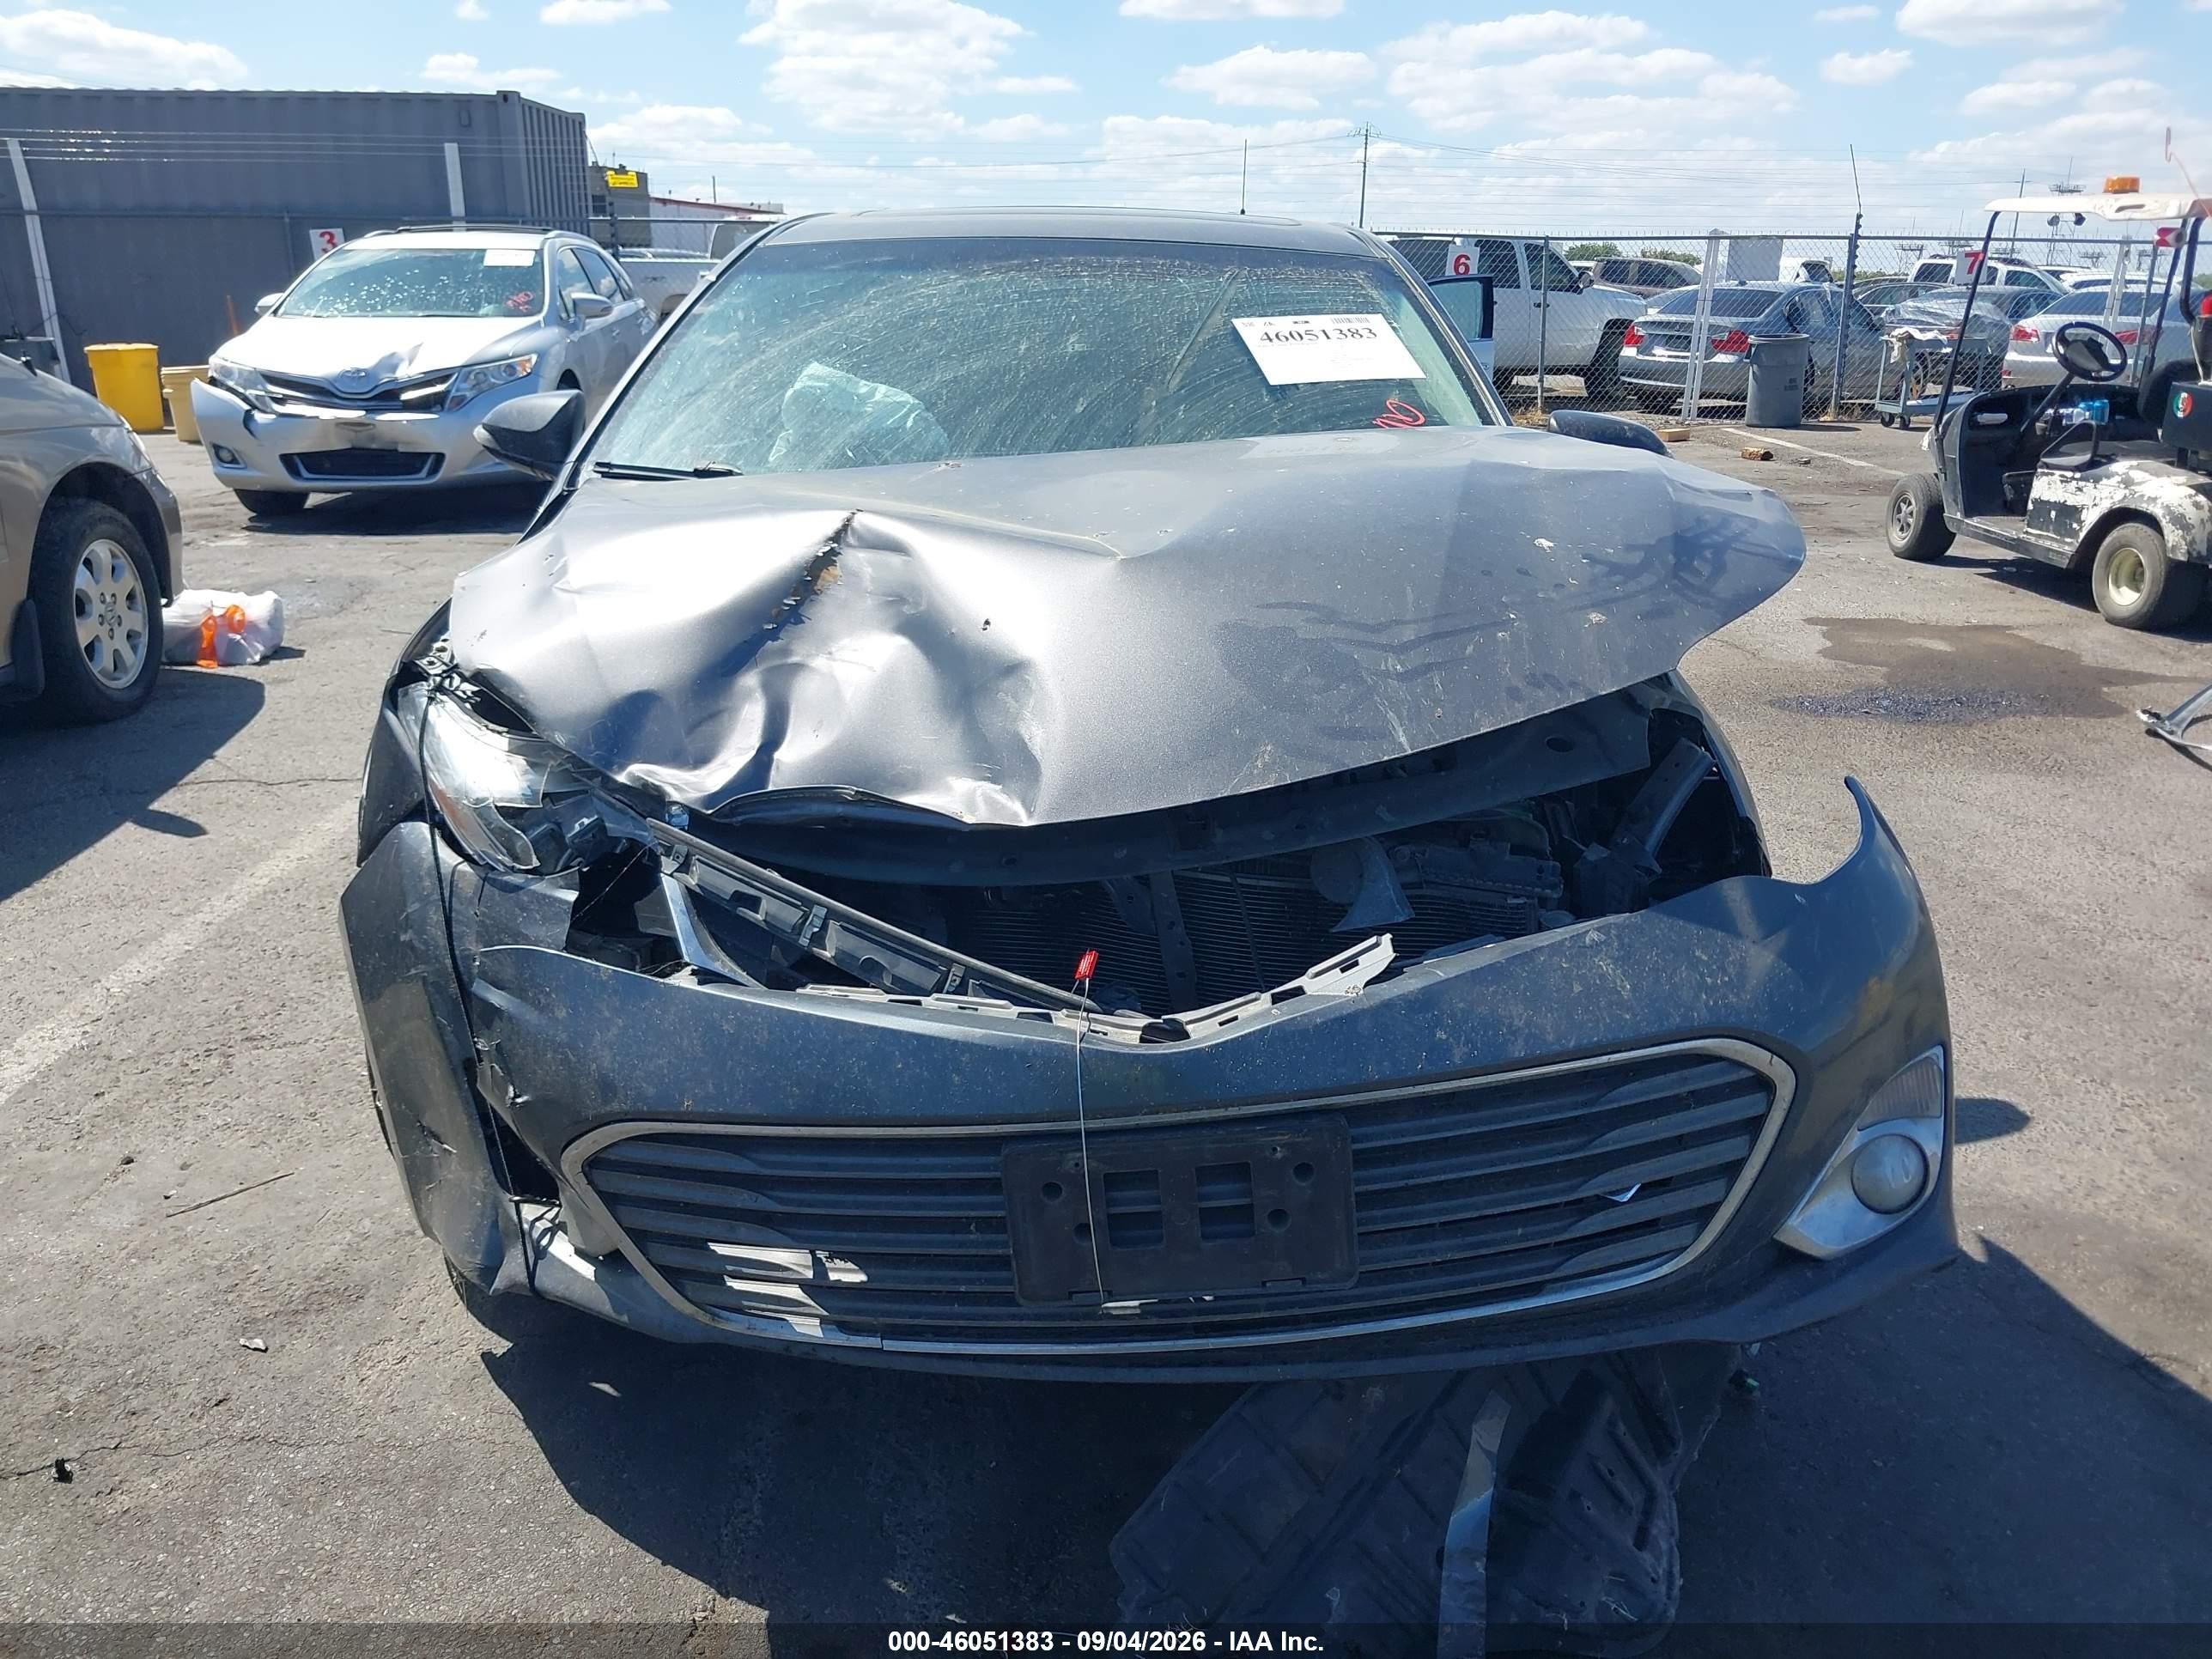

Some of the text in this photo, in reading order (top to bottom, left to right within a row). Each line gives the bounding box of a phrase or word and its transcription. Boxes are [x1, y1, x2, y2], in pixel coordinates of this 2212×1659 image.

[319, 231, 337, 254] 3
[1454, 254, 1470, 275] 6
[1965, 252, 1984, 275] 7
[1260, 327, 1377, 343] 46051383
